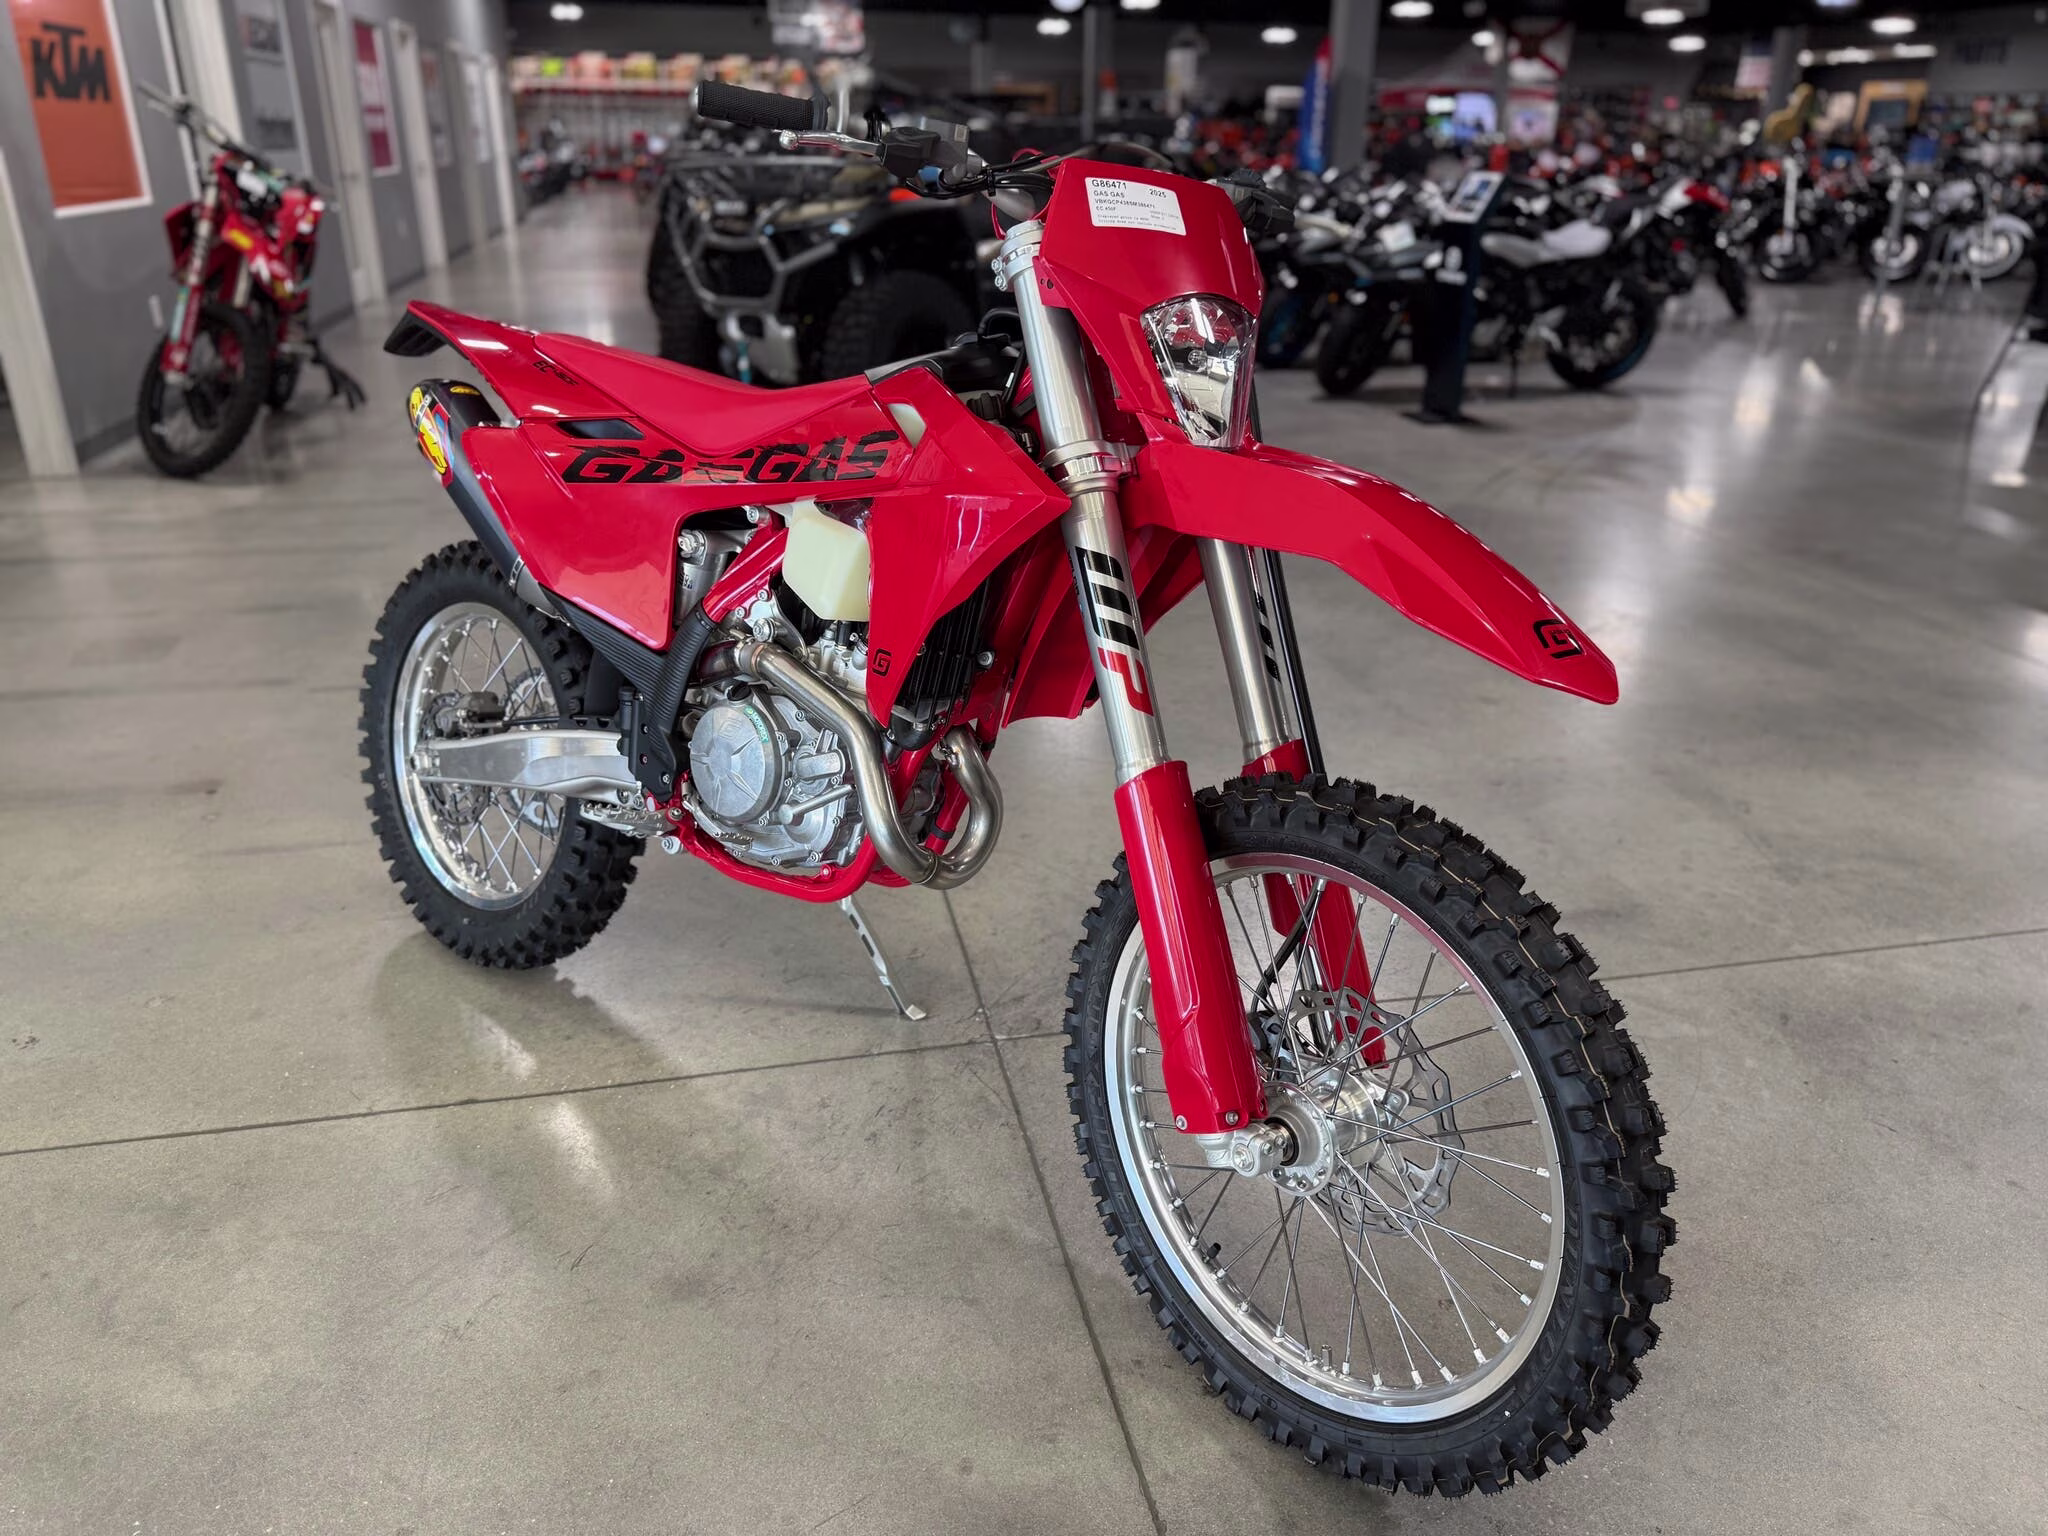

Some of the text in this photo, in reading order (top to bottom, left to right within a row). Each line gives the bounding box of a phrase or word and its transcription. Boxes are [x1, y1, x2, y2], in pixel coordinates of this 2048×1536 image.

[28, 21, 112, 103] KTM
[1091, 179, 1127, 190] G86471
[1149, 188, 1167, 198] 2025
[1075, 546, 1154, 717] WP
